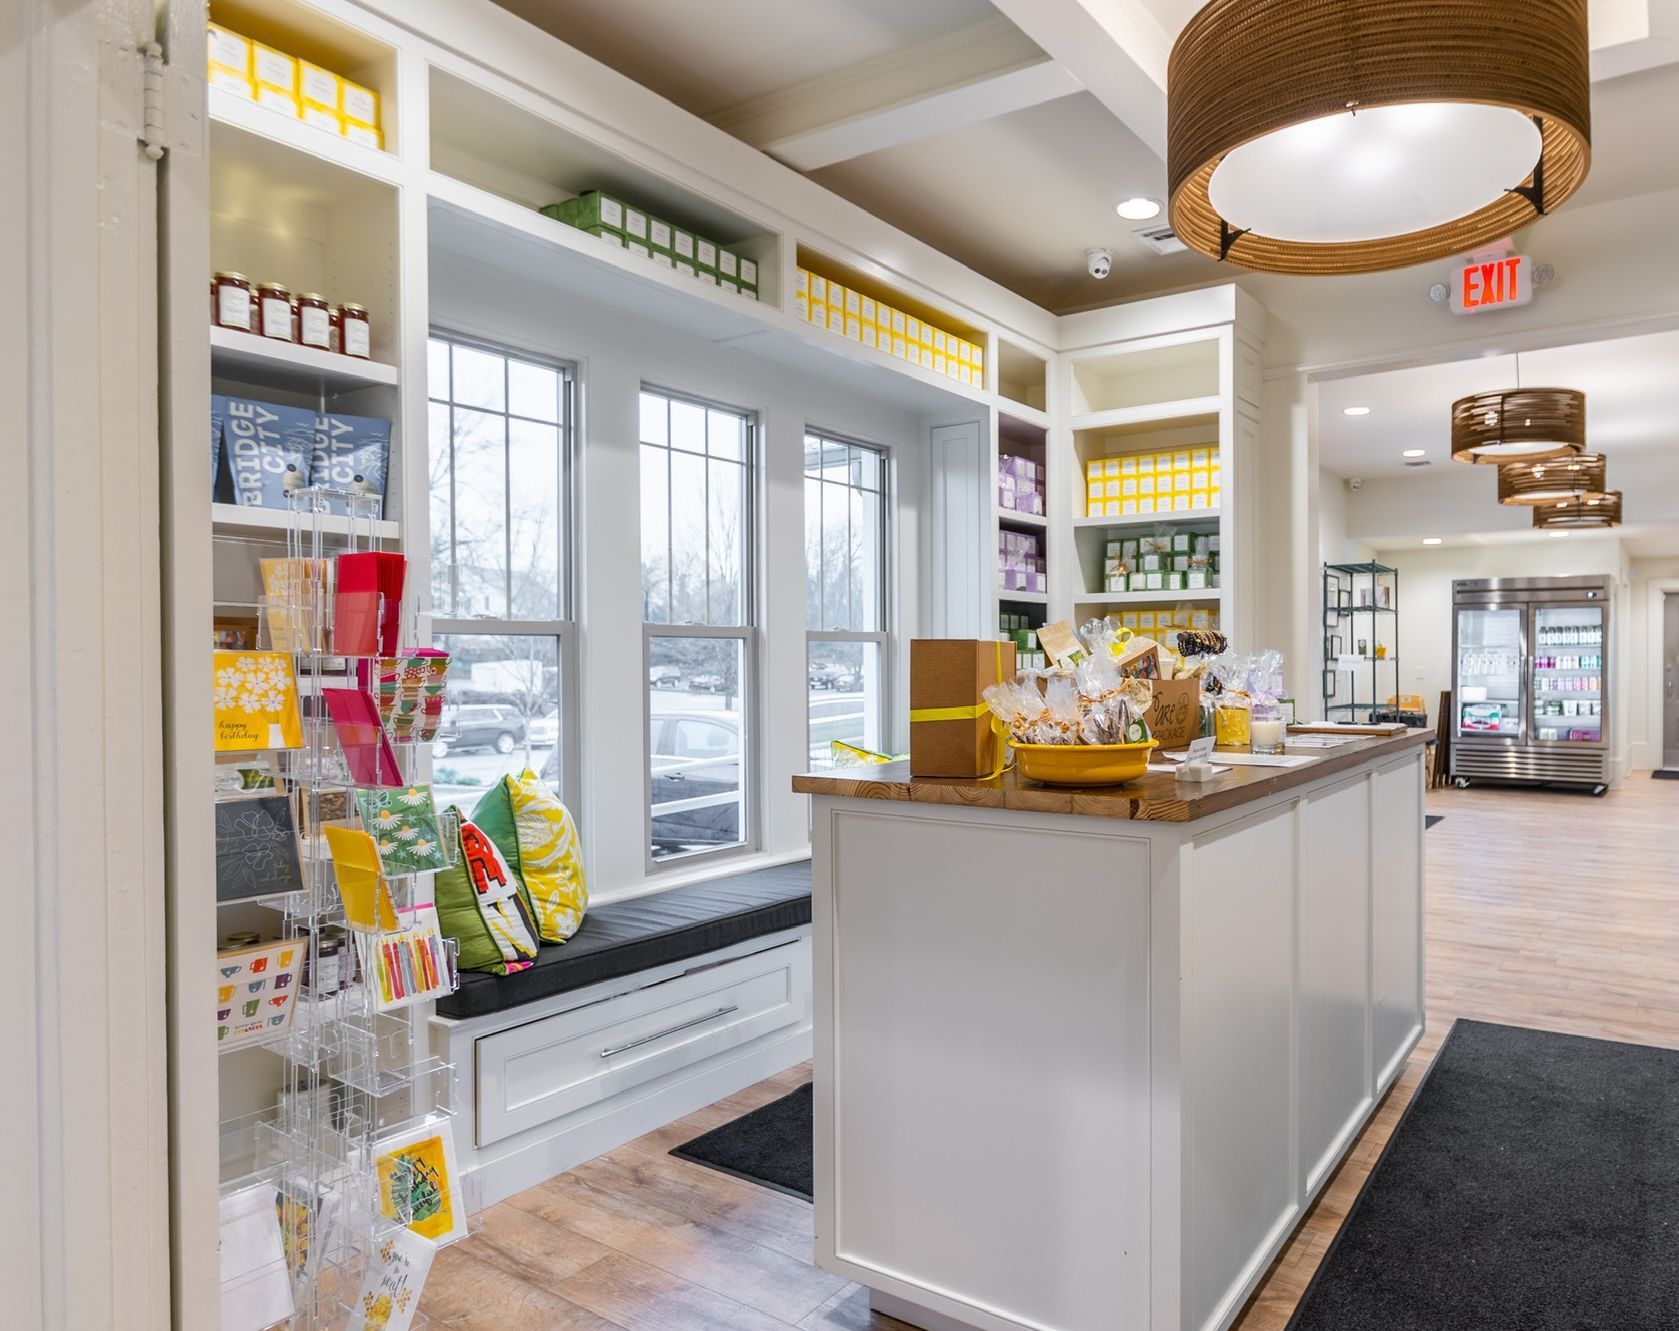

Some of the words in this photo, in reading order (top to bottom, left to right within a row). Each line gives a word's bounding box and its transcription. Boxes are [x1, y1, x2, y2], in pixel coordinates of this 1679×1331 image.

[463, 257, 521, 308] EXIT
[230, 402, 263, 506] BRIDGE
[256, 405, 286, 474] CITY
[331, 418, 354, 483] CITY
[219, 720, 247, 730] happy
[220, 731, 259, 741] birthday
